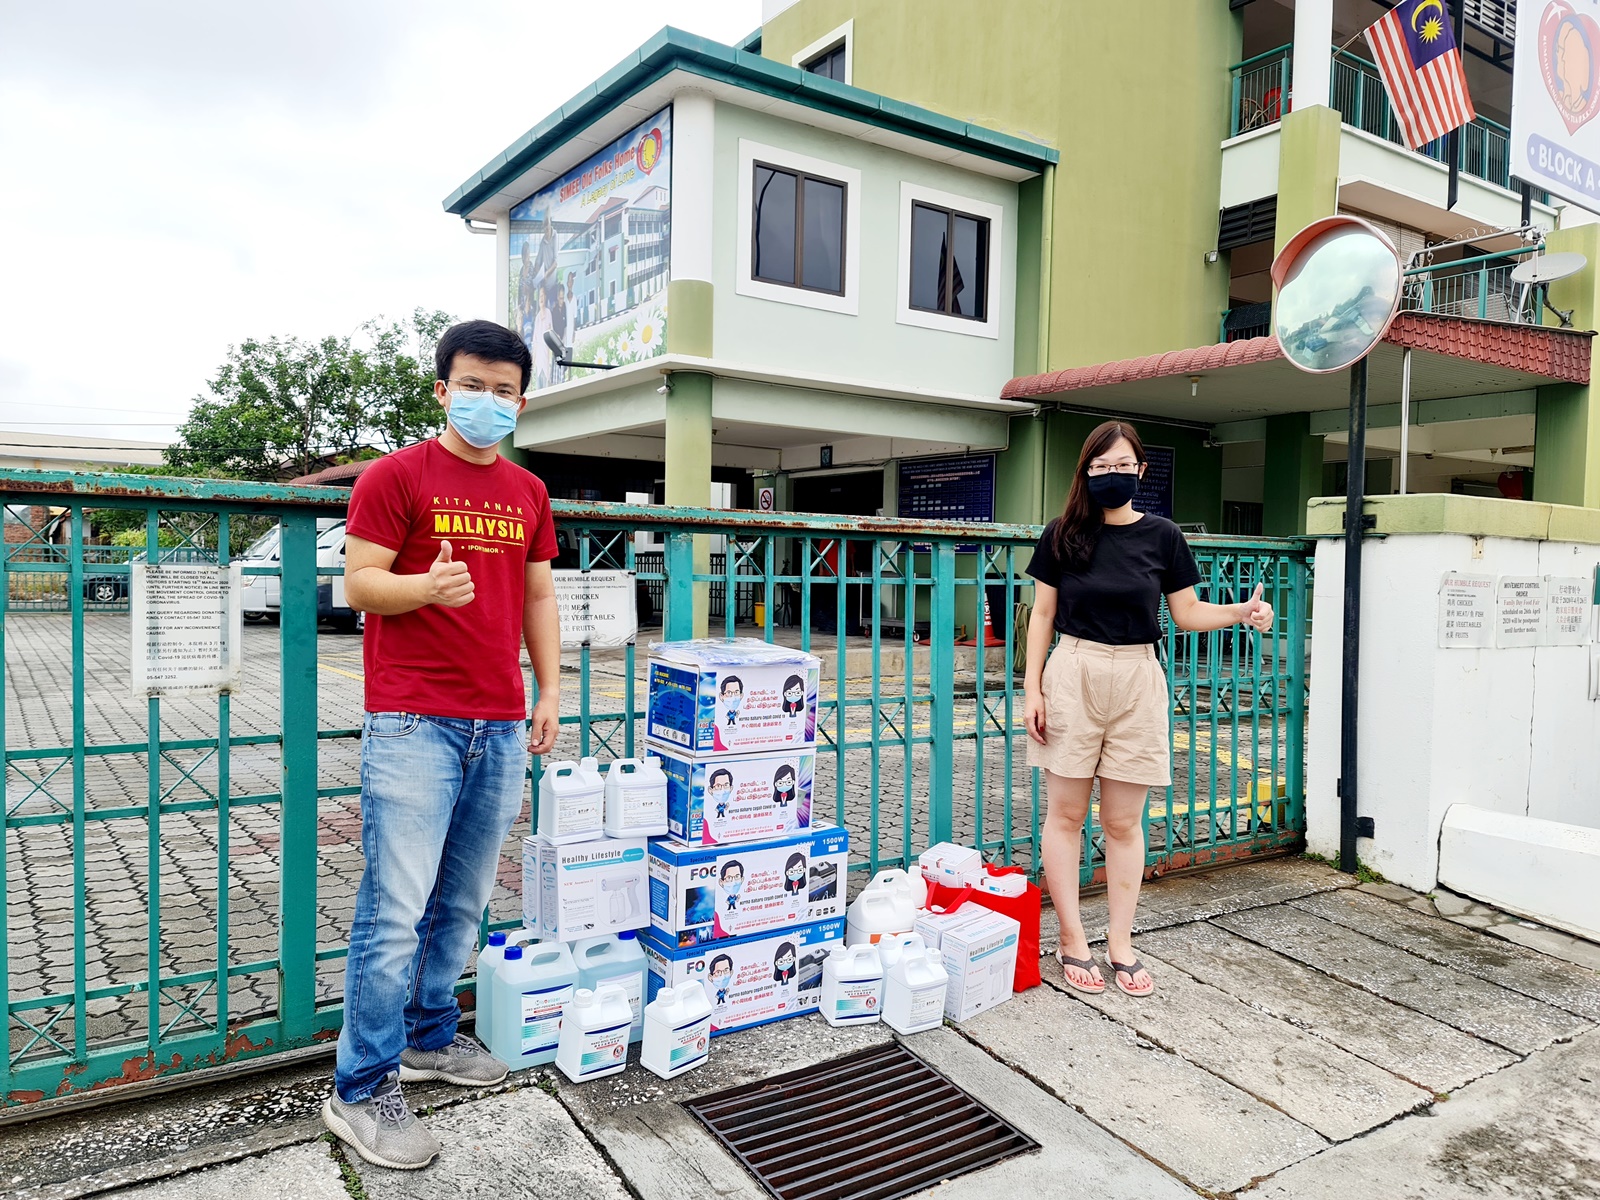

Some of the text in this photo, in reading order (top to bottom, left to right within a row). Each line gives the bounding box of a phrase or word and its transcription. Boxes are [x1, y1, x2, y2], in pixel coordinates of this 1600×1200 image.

[560, 147, 634, 203] SIMEE Old Folks Home
[1539, 144, 1594, 191] BLOCK A
[580, 168, 635, 208] A Legacy of Love
[434, 497, 522, 514] KITA ANAK
[435, 515, 524, 540] MALAYSIA
[1472, 580, 1491, 588] REQUEST
[823, 836, 844, 844] 1500W
[562, 855, 588, 864] Healthy
[591, 850, 621, 860] Lifestyle
[650, 856, 670, 872] MACHINE
[690, 866, 716, 880] FOG
[819, 922, 840, 931] 1500W
[970, 938, 1003, 956] Healthy Lifestyle
[687, 960, 705, 974] FO
